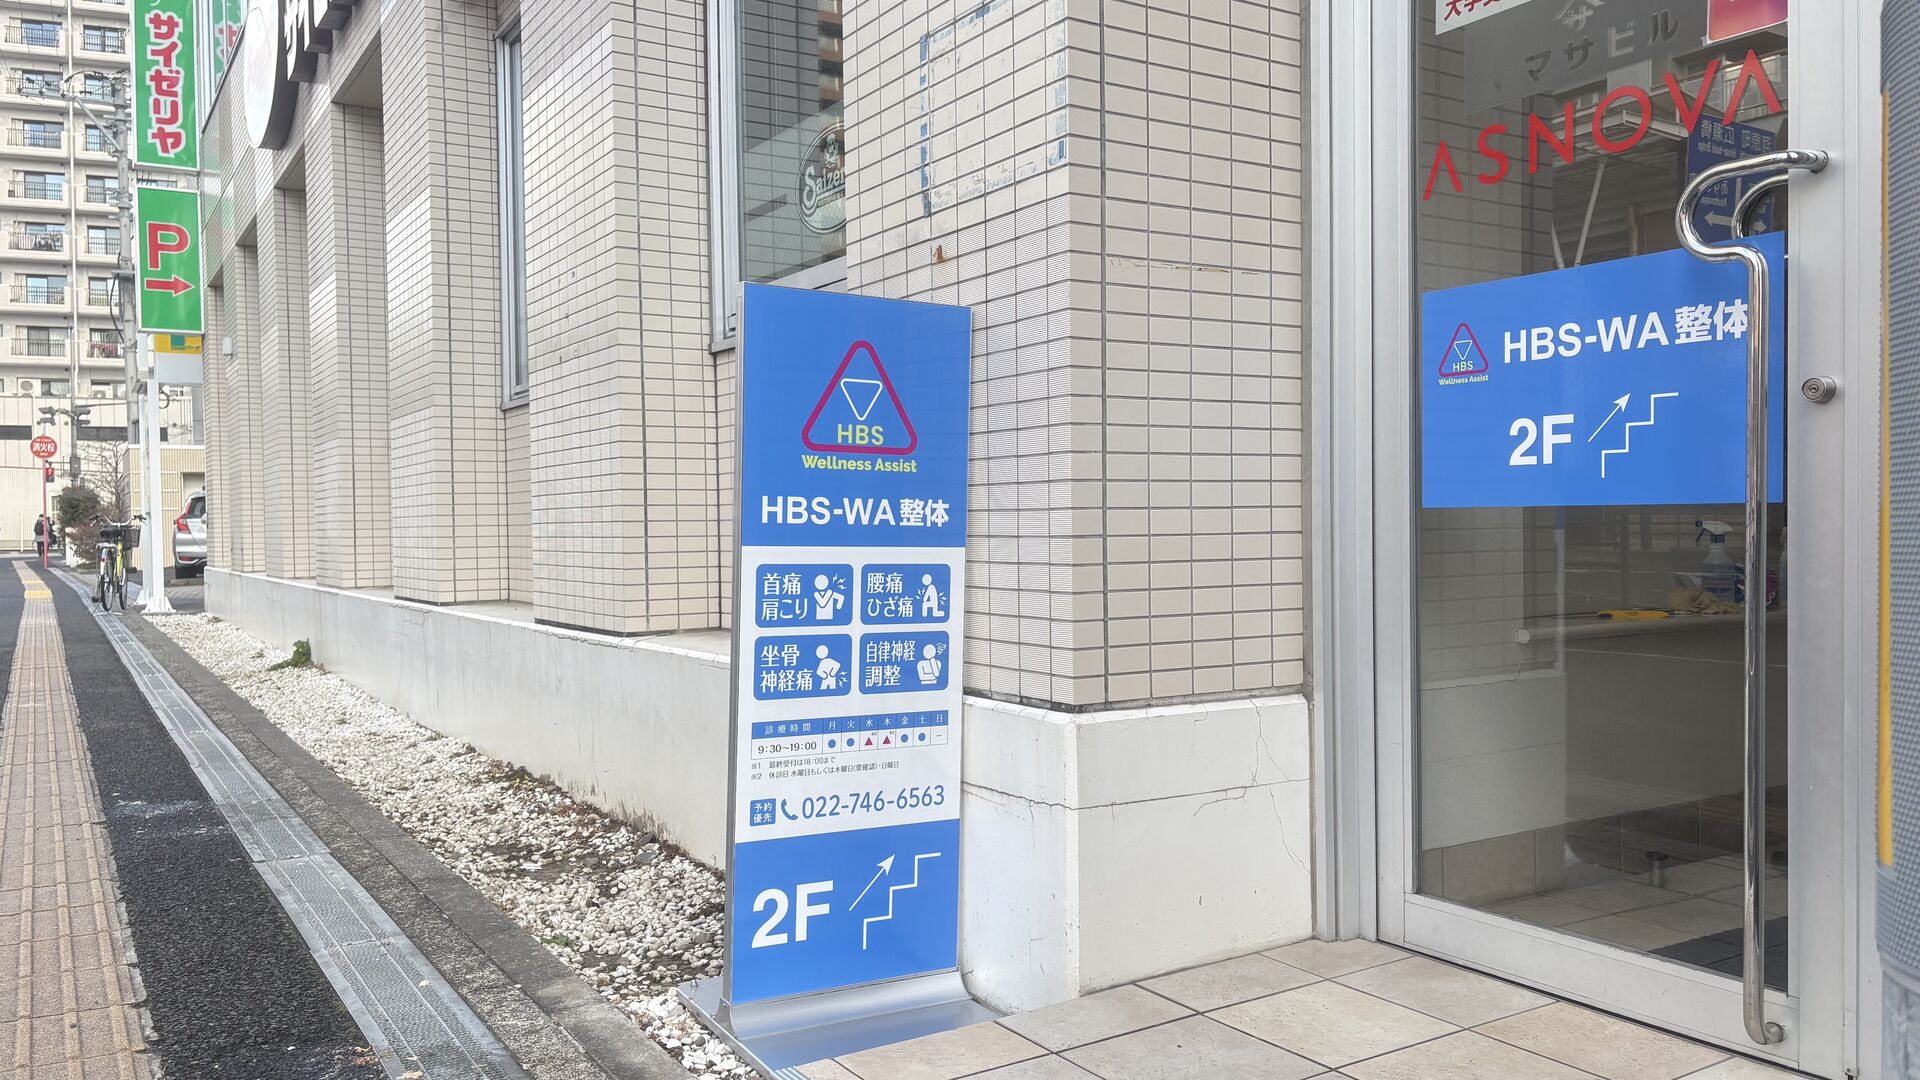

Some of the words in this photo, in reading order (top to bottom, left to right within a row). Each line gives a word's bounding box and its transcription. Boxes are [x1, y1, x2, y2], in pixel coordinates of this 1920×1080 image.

[147, 11, 183, 156] サイゼリヤ
[1423, 47, 1784, 201] ASNOVA
[147, 221, 190, 270] P
[1504, 311, 1669, 364] HBS-WA
[1675, 298, 1748, 345] 整体
[1453, 360, 1474, 373] HBS
[1439, 377, 1468, 386] Wellness
[1469, 374, 1489, 383] Assist
[837, 423, 884, 446] HBS
[1509, 413, 1574, 466] 2F
[801, 455, 872, 471] Wellness
[874, 458, 917, 473] Assist
[761, 495, 897, 526] HBS-WA
[900, 498, 950, 527] 整体
[762, 572, 802, 596] 首痛
[866, 572, 904, 594] 腰痛
[761, 598, 808, 621] 肩こり
[867, 595, 914, 618] ひざ痛
[760, 644, 800, 668] 坐骨
[866, 640, 916, 663] 自律神経
[760, 669, 813, 693] 神経痛
[865, 664, 901, 688] 調整
[764, 722, 811, 735] 診療時間
[828, 720, 836, 731] 月
[846, 719, 855, 729] 火
[865, 717, 874, 728] 水
[883, 717, 892, 727] 木
[900, 715, 909, 725] 金
[919, 714, 926, 724] 土
[936, 713, 943, 723] 日
[753, 802, 773, 812] 予約
[801, 784, 946, 820] 022-746-6563
[753, 812, 773, 824] 優先
[751, 879, 834, 949] 2F
